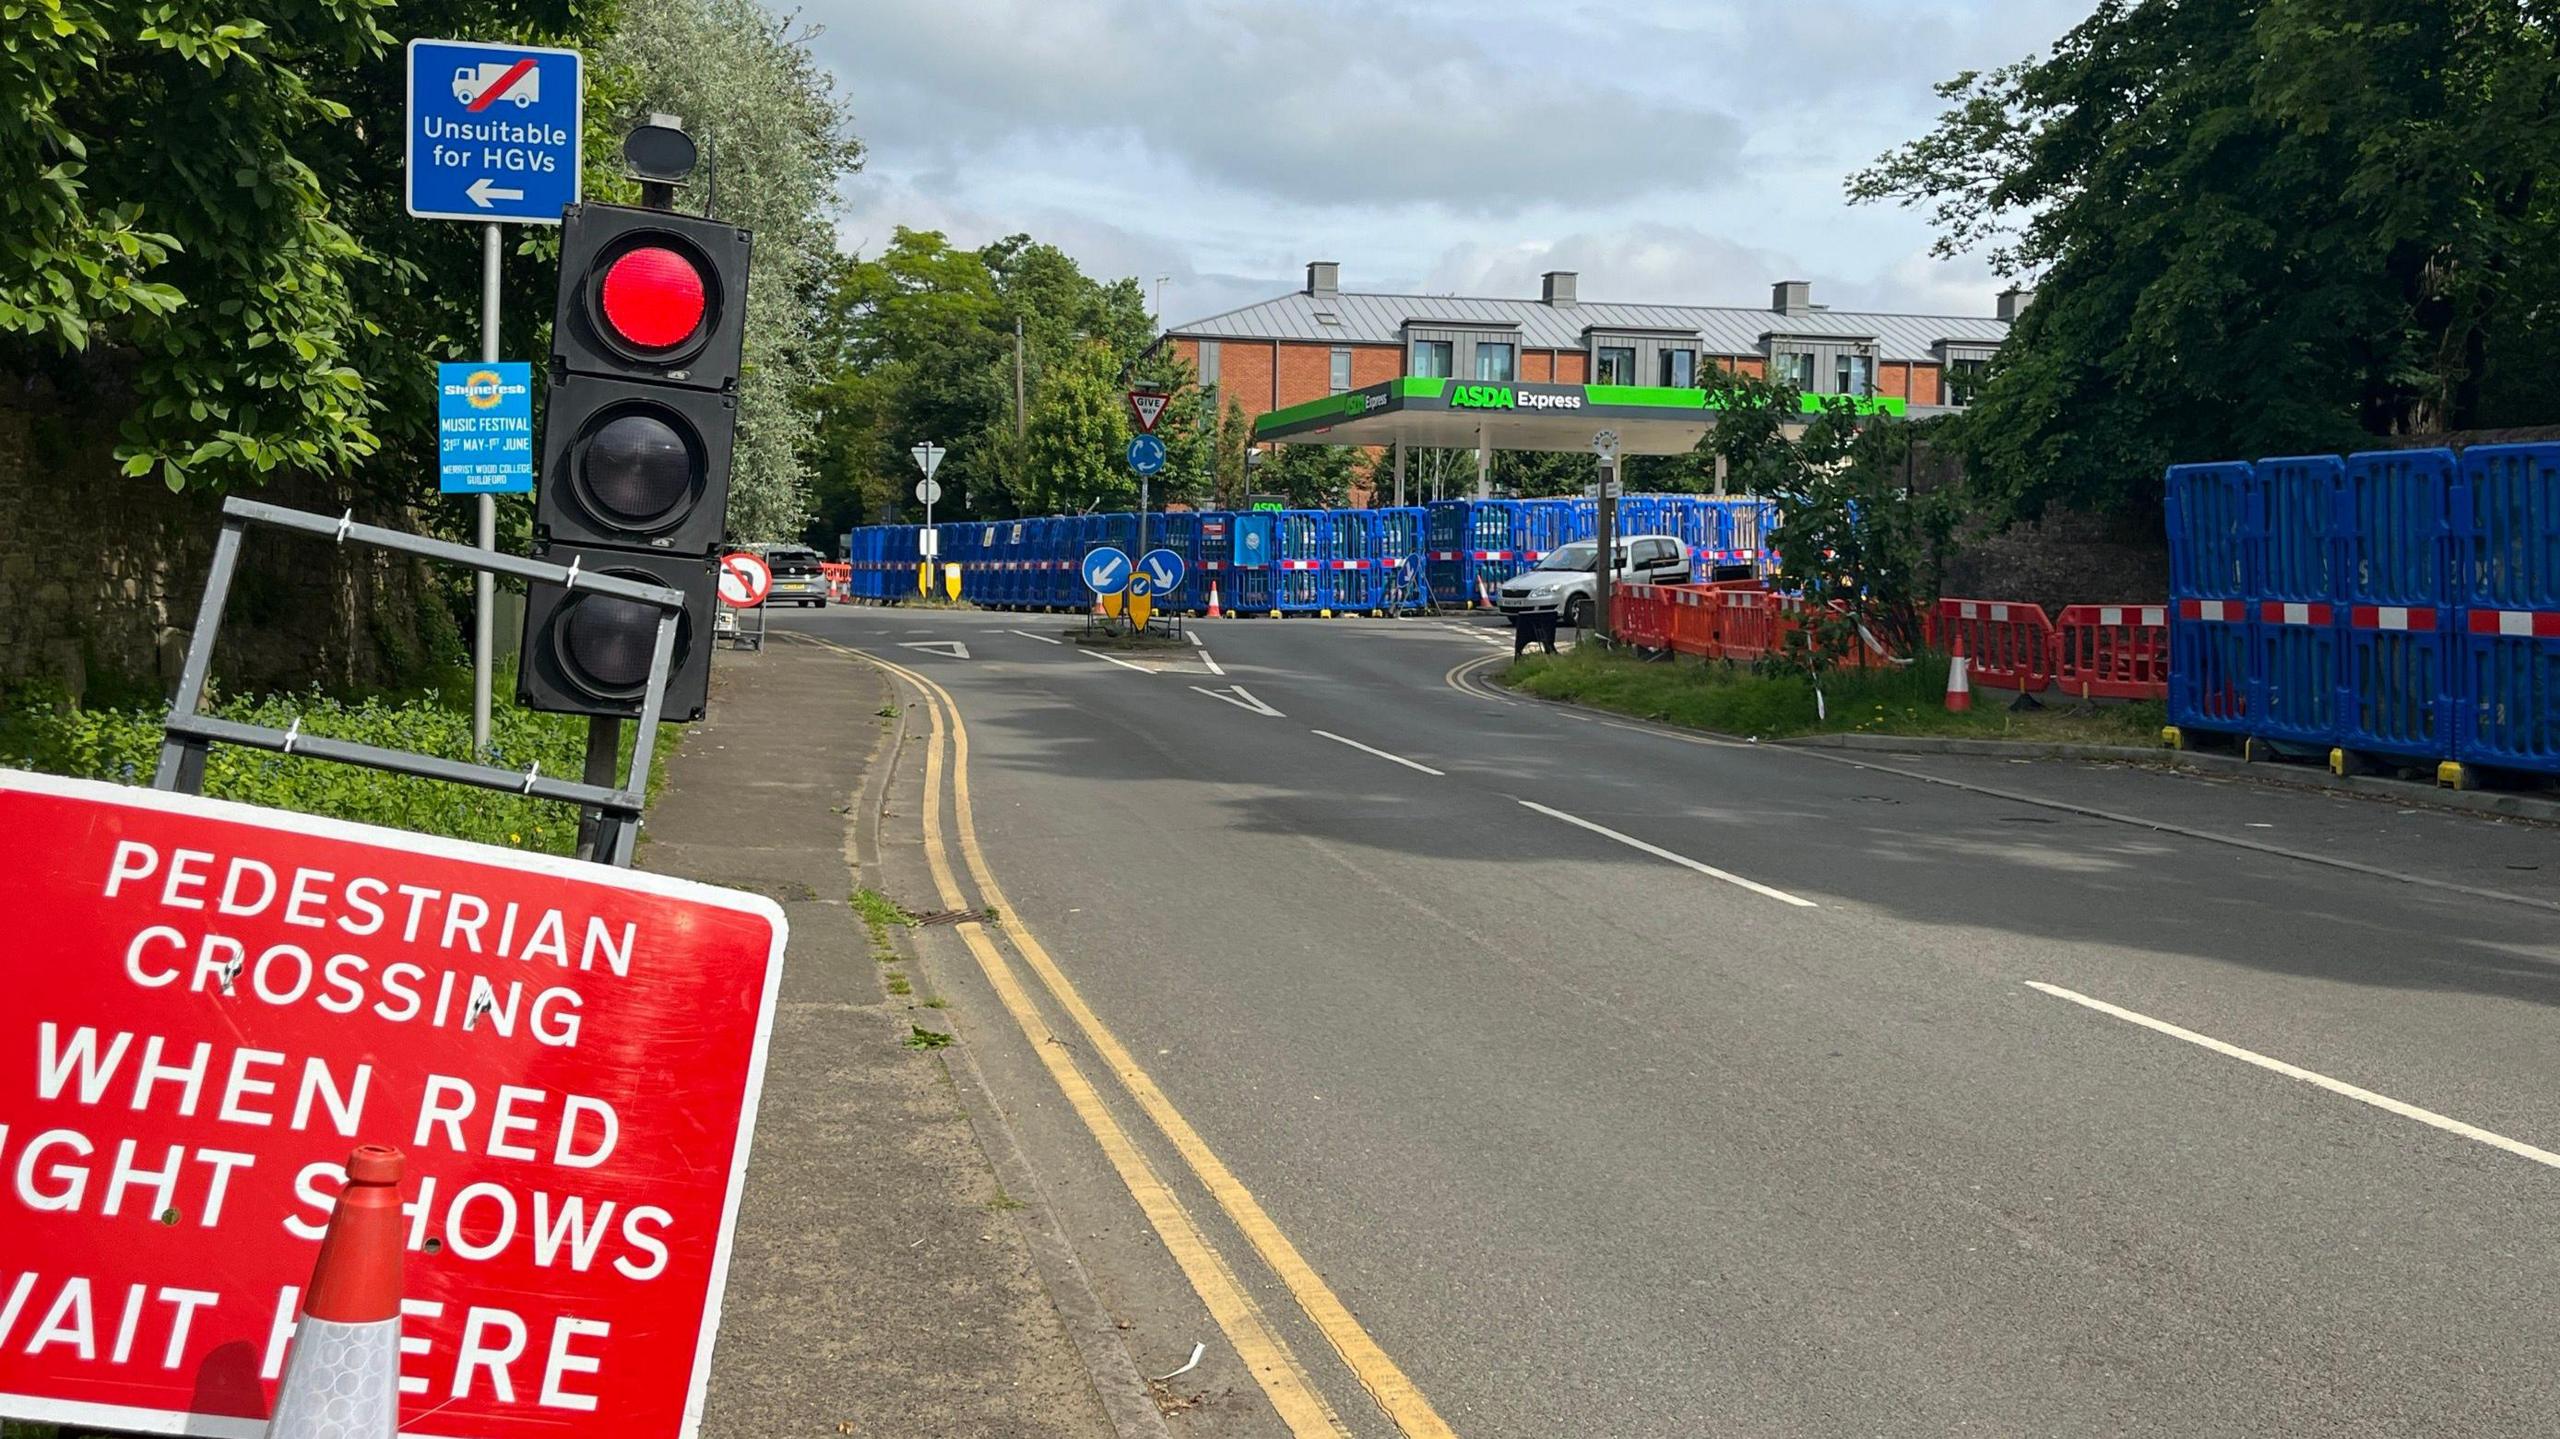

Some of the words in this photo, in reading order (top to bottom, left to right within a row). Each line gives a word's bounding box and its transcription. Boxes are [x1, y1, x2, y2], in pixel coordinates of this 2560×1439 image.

[424, 115, 567, 146] Unsuitable
[433, 145, 471, 167] for
[483, 147, 555, 172] HGVs
[1136, 397, 1160, 407] GIVE
[1451, 385, 1515, 409] ASDA
[1517, 391, 1581, 411] Express
[441, 418, 476, 433] MUSIC
[479, 417, 530, 432] FESTIVAL
[502, 437, 529, 451] JUNE
[442, 464, 473, 475] MERRIST
[475, 464, 498, 474] WOOD
[499, 463, 531, 474] COLLEGE
[466, 475, 507, 485] GUILDFORD
[1252, 502, 1283, 512] ASDA
[104, 840, 637, 977] PEDESTRIAN
[126, 925, 583, 1047] CROSSING
[38, 1022, 372, 1138] WHEN
[413, 1074, 619, 1169] RED
[0, 1123, 256, 1228] GHT
